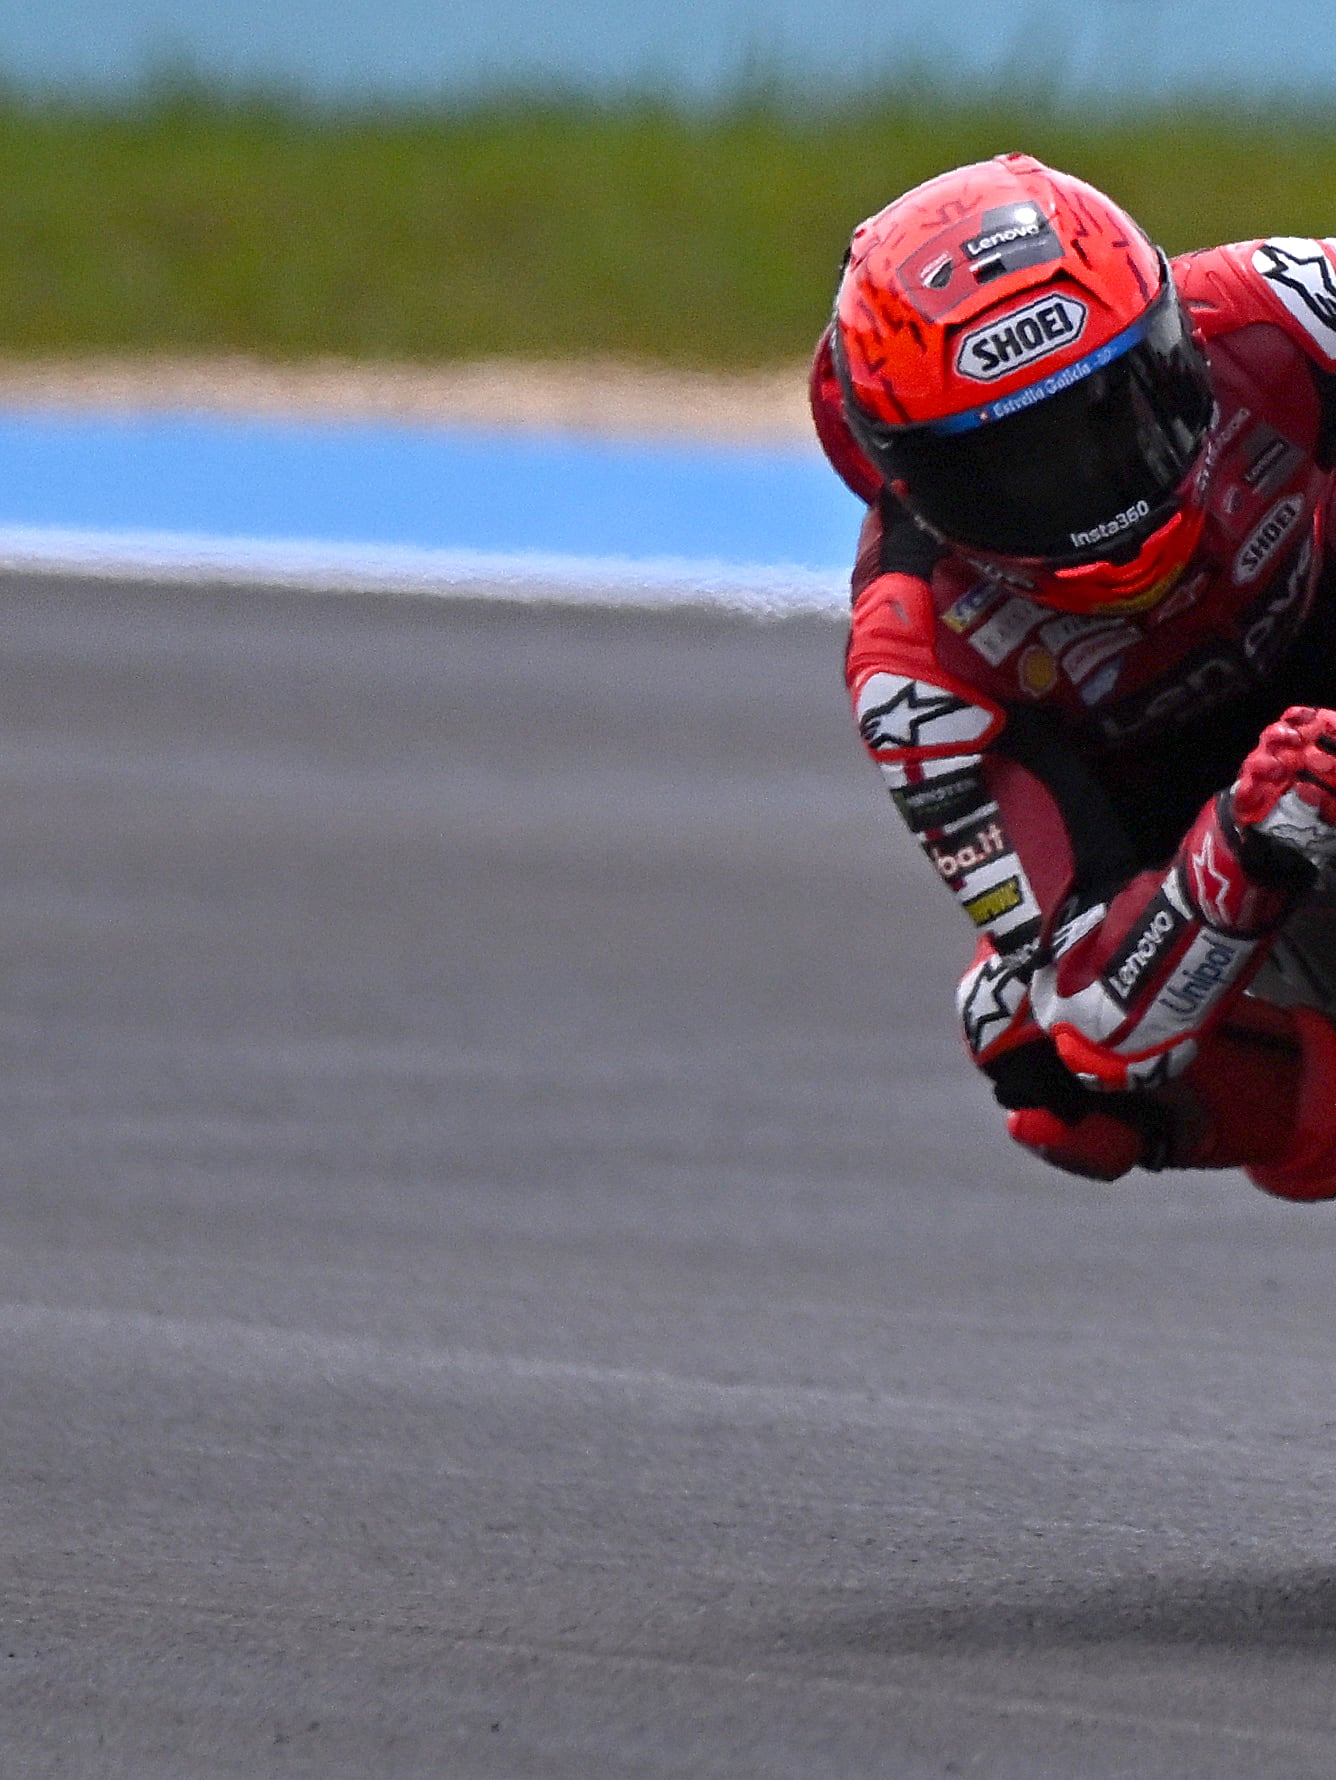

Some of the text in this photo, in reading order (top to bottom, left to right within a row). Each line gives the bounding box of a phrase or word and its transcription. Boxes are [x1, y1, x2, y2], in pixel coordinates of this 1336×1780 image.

[966, 224, 1040, 256] Lenovo
[972, 301, 1075, 372] SHOEI
[1070, 499, 1150, 549] Insta360
[1108, 910, 1175, 999] Lenovo
